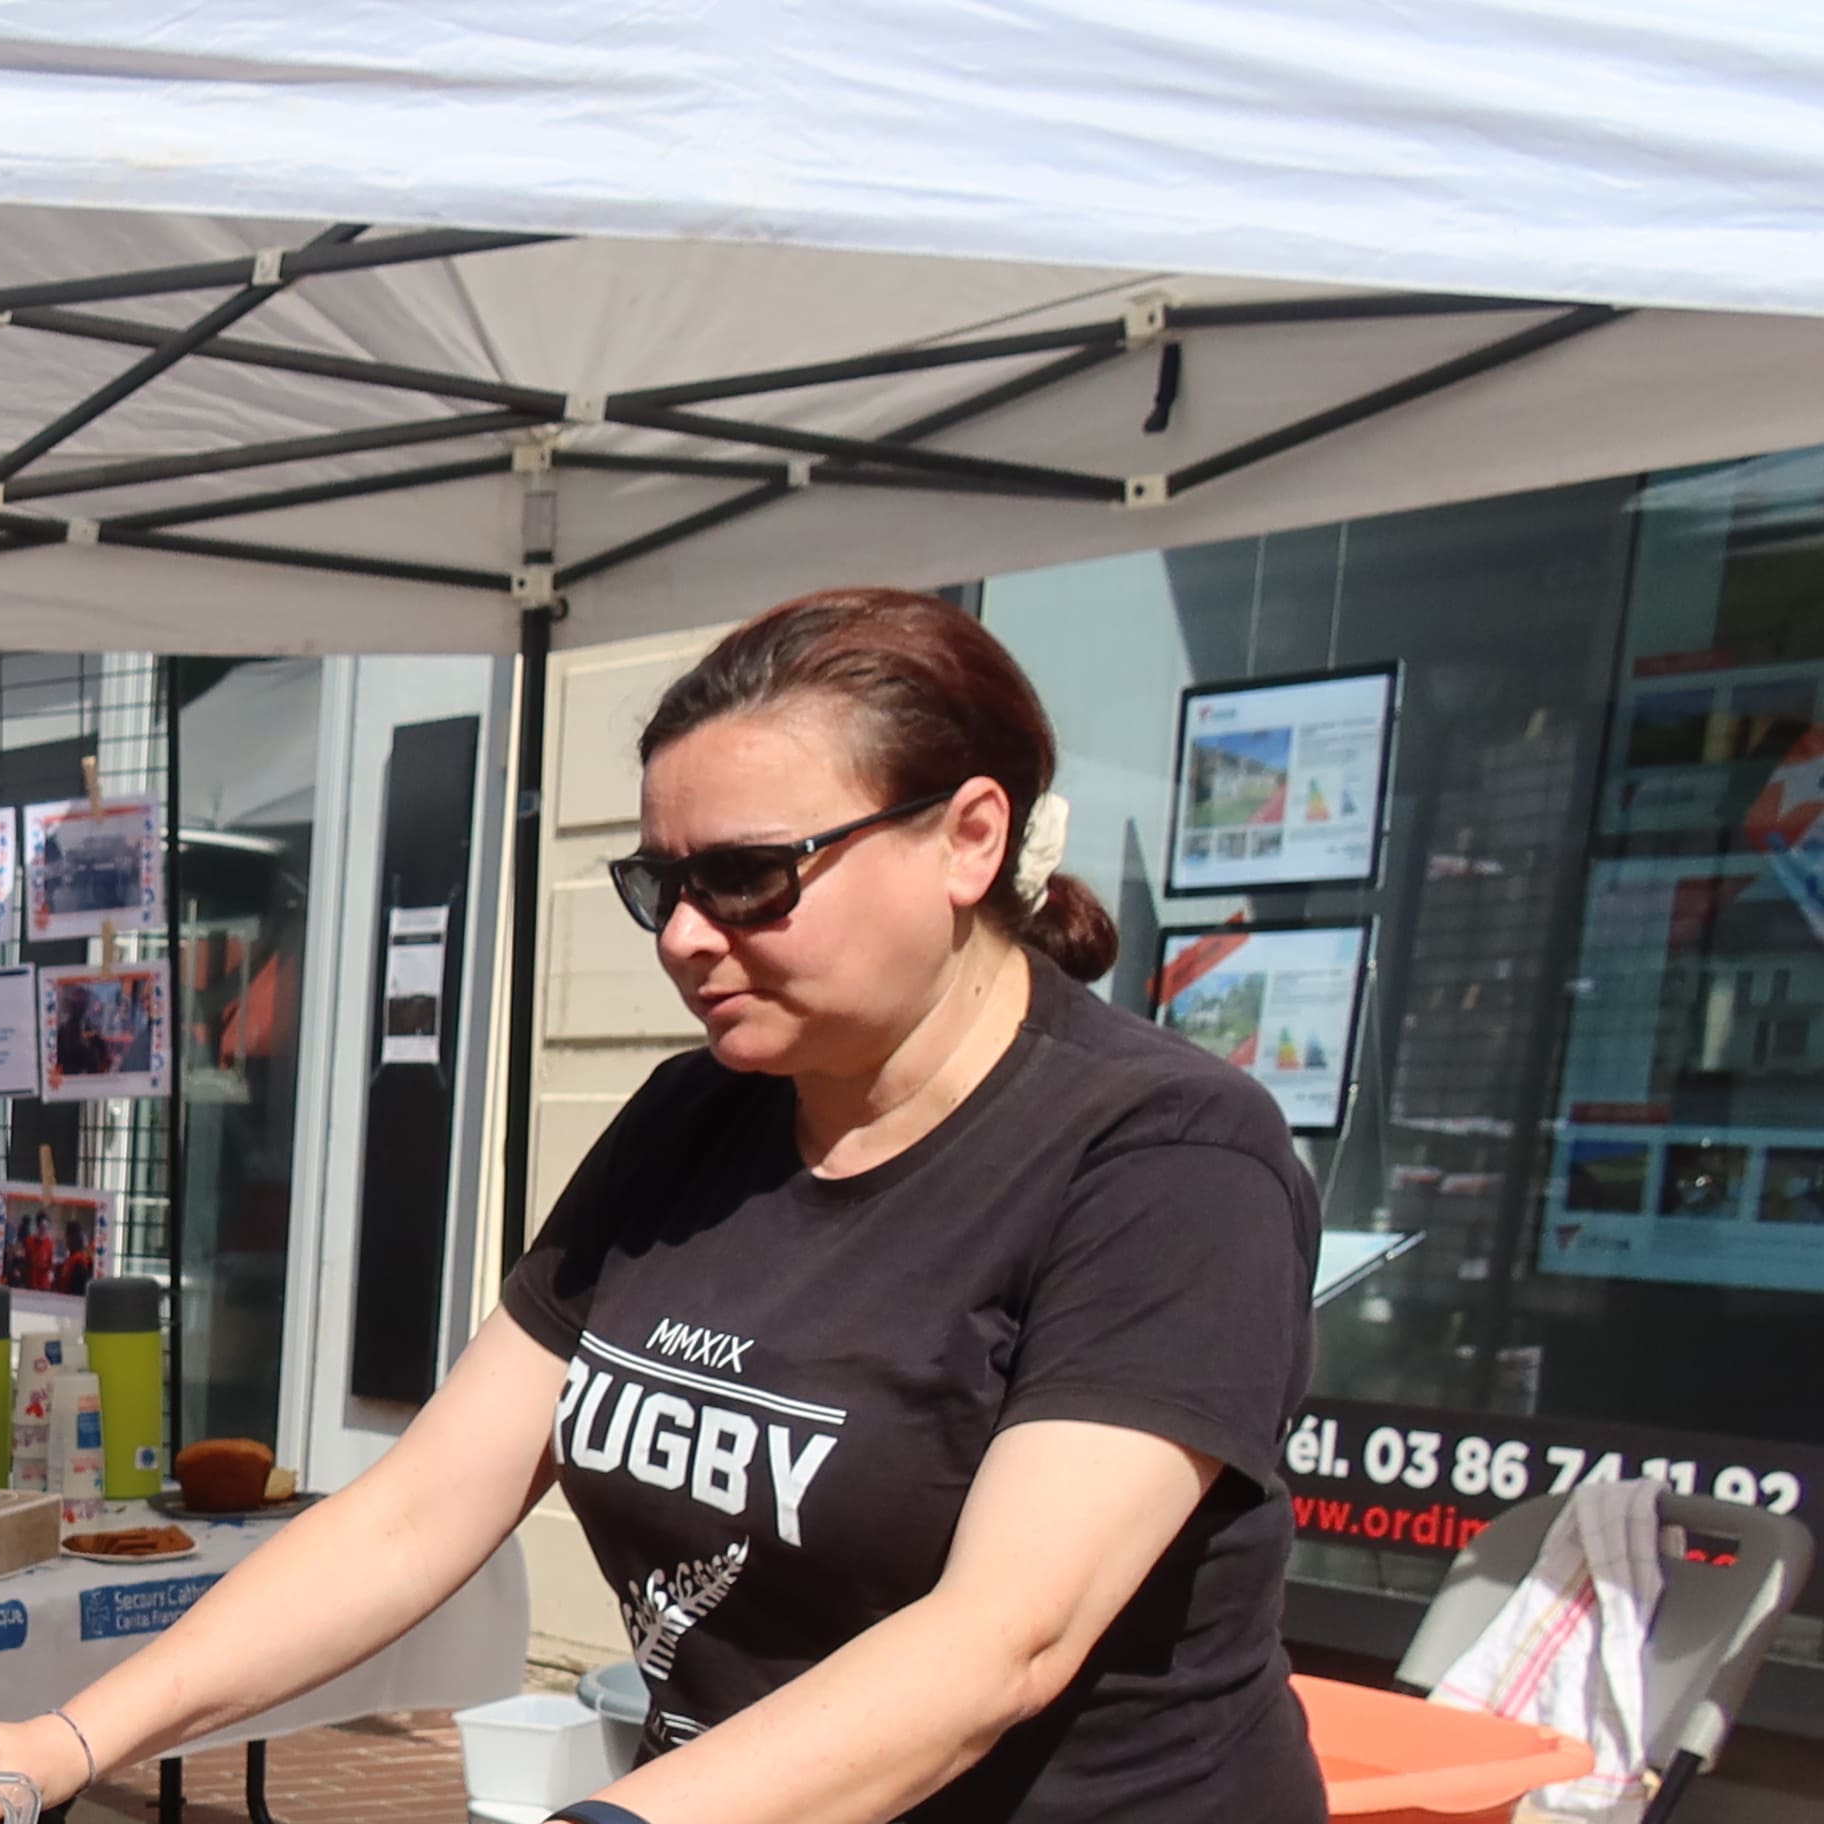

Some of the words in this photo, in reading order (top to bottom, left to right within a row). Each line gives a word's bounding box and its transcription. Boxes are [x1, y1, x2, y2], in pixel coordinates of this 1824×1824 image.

[646, 1318, 754, 1373] MMXIX
[554, 1355, 839, 1548] RUGBY
[1286, 1413, 1351, 1479] él.
[1362, 1426, 1442, 1489] 03
[1450, 1436, 1531, 1500] 86
[1713, 1466, 1803, 1516] 92
[114, 1590, 166, 1613] Secours
